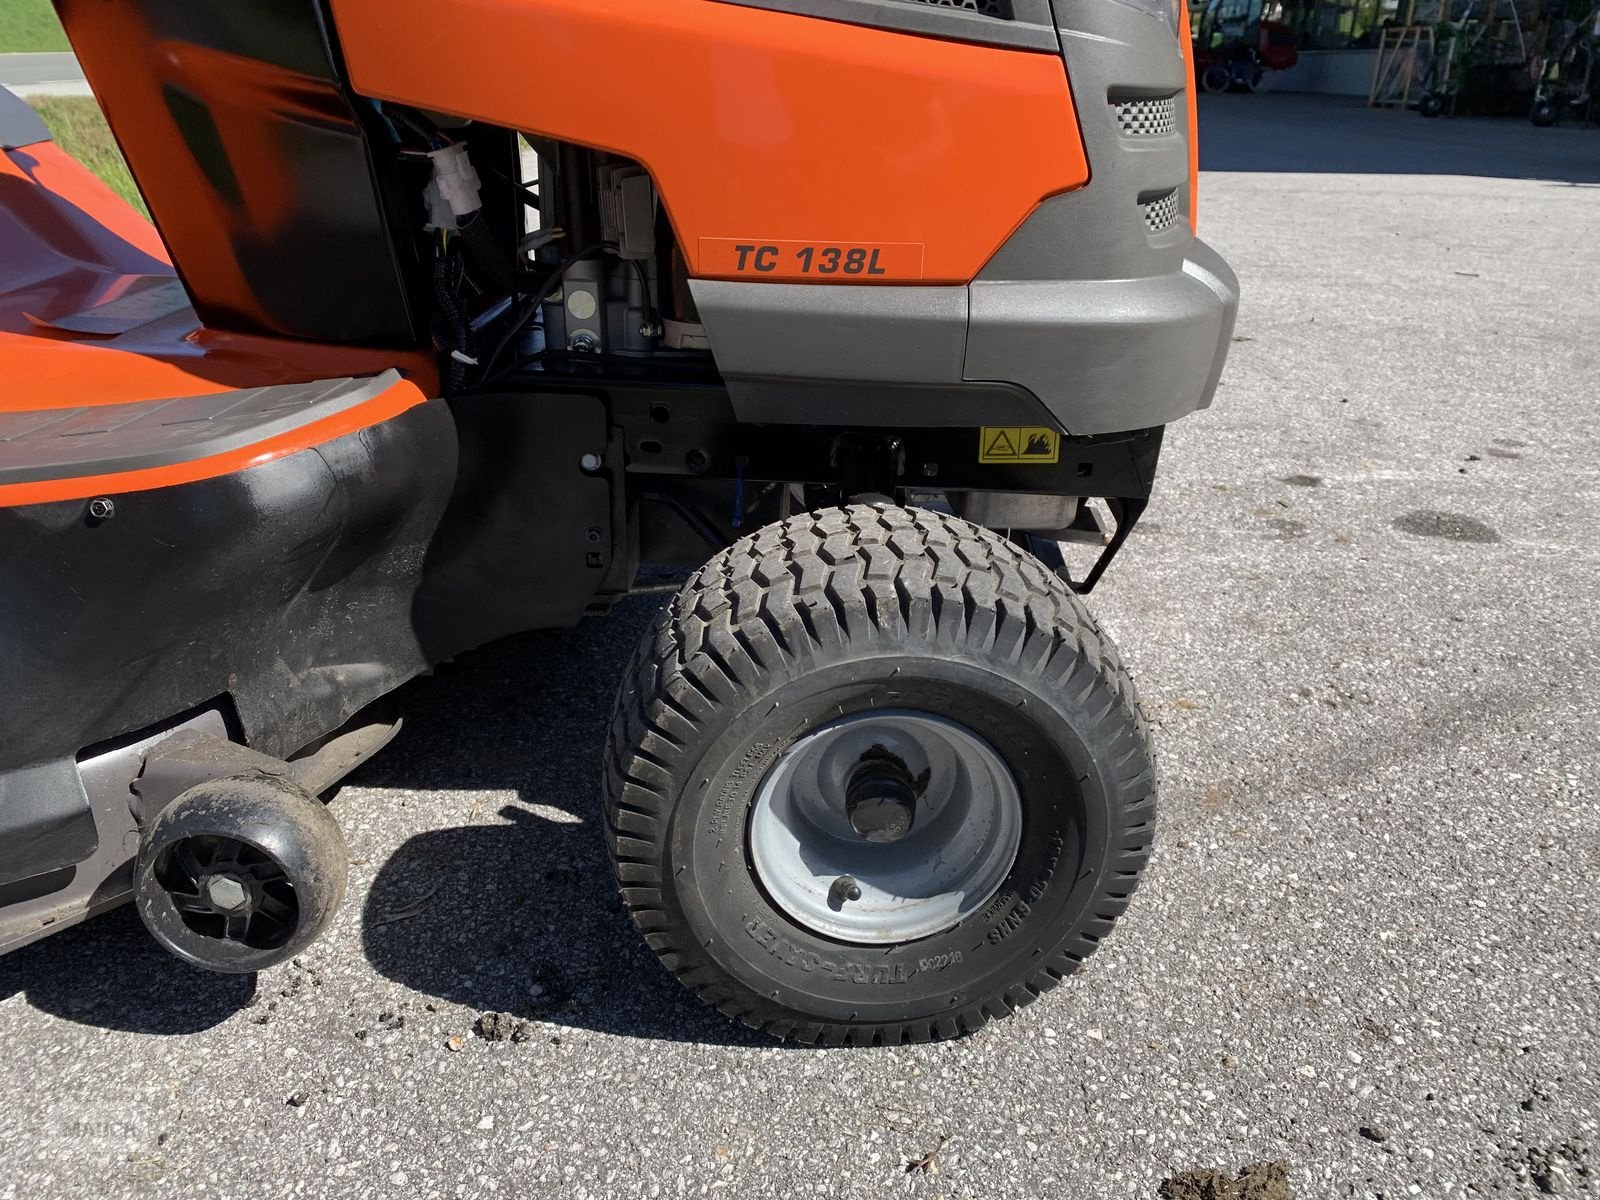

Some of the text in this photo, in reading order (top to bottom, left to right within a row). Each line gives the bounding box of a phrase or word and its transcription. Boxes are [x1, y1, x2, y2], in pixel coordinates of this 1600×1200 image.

[735, 246, 886, 275] TC 138L
[744, 916, 908, 985] TURF-SAVER
